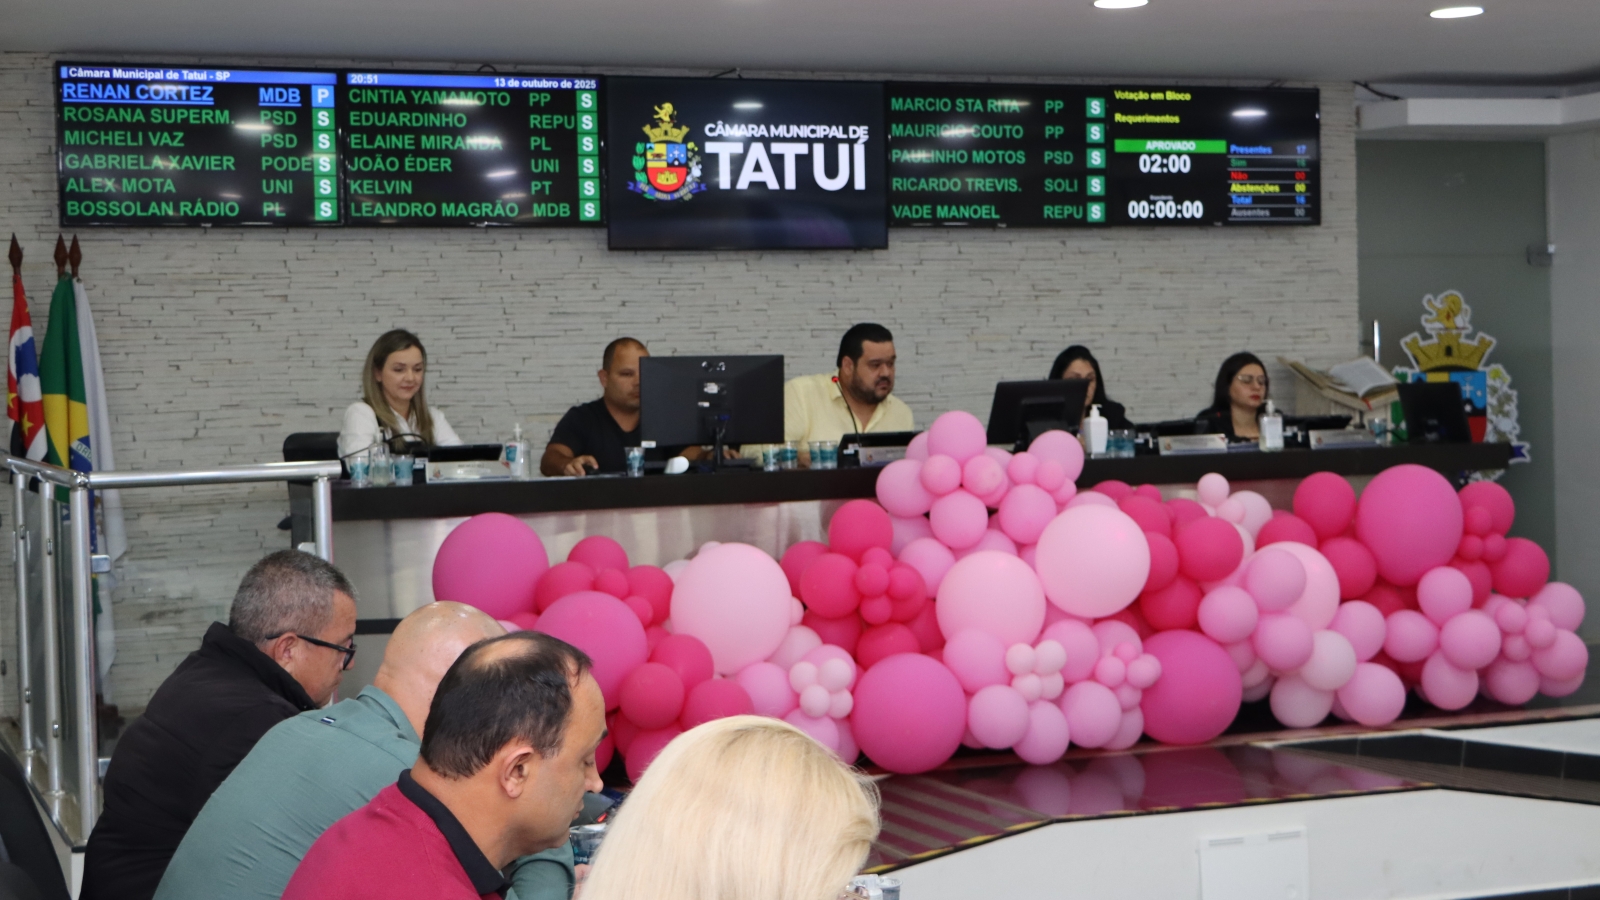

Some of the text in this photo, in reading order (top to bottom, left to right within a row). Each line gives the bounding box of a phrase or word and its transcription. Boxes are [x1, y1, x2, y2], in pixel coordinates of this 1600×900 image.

[69, 67, 110, 78] Câmara
[113, 69, 163, 80] Municipal
[166, 70, 179, 80] de
[215, 72, 230, 81] SP
[351, 74, 378, 84] 20:51
[494, 77, 596, 89] 13 de outubro de 2025
[63, 83, 329, 103] RENAN CORTEZ MDB P
[349, 89, 593, 108] CINTIA YAMAMOTO PP S
[1114, 90, 1149, 101] Votação
[1166, 90, 1191, 101] Bloco
[891, 97, 1101, 115] MARCIO STA RITA PP S
[63, 107, 330, 126] ROSANA SUPERM. PSD S
[350, 112, 593, 130] EDUARDINHO REPU S
[1114, 112, 1180, 124] Requerimentos
[704, 121, 868, 139] CÂMARA MUNICIPAL DE
[891, 124, 1101, 140] MAURICIO COUTO PP S
[64, 130, 330, 149] MICHELI VAZ PSD S
[351, 134, 594, 151] ELAINE MIRANDA PL S
[1146, 141, 1196, 151] APROVADO
[892, 149, 1101, 165] PAULINHO MOTOS PSD S
[1230, 144, 1273, 154] Presentes
[65, 154, 331, 172] GABRIELA XAVIER PODE S
[349, 154, 594, 173] JOÃO ÉDER UNI S
[704, 137, 868, 191] TATUÍ
[1139, 154, 1191, 173] 02:00
[65, 178, 331, 195] ALEX MOTA UNI S
[350, 180, 595, 196] KELVIN PT S
[892, 178, 1101, 193] RICARDO TREVIS. SOLI S
[67, 198, 332, 217] BOSSOLAN RÁDIO PL S
[351, 199, 595, 217] LEANDRO MAGRÃO MDB S
[892, 205, 1101, 219] VADE MANOEL REPU S
[1128, 200, 1203, 219] 00:00:00
